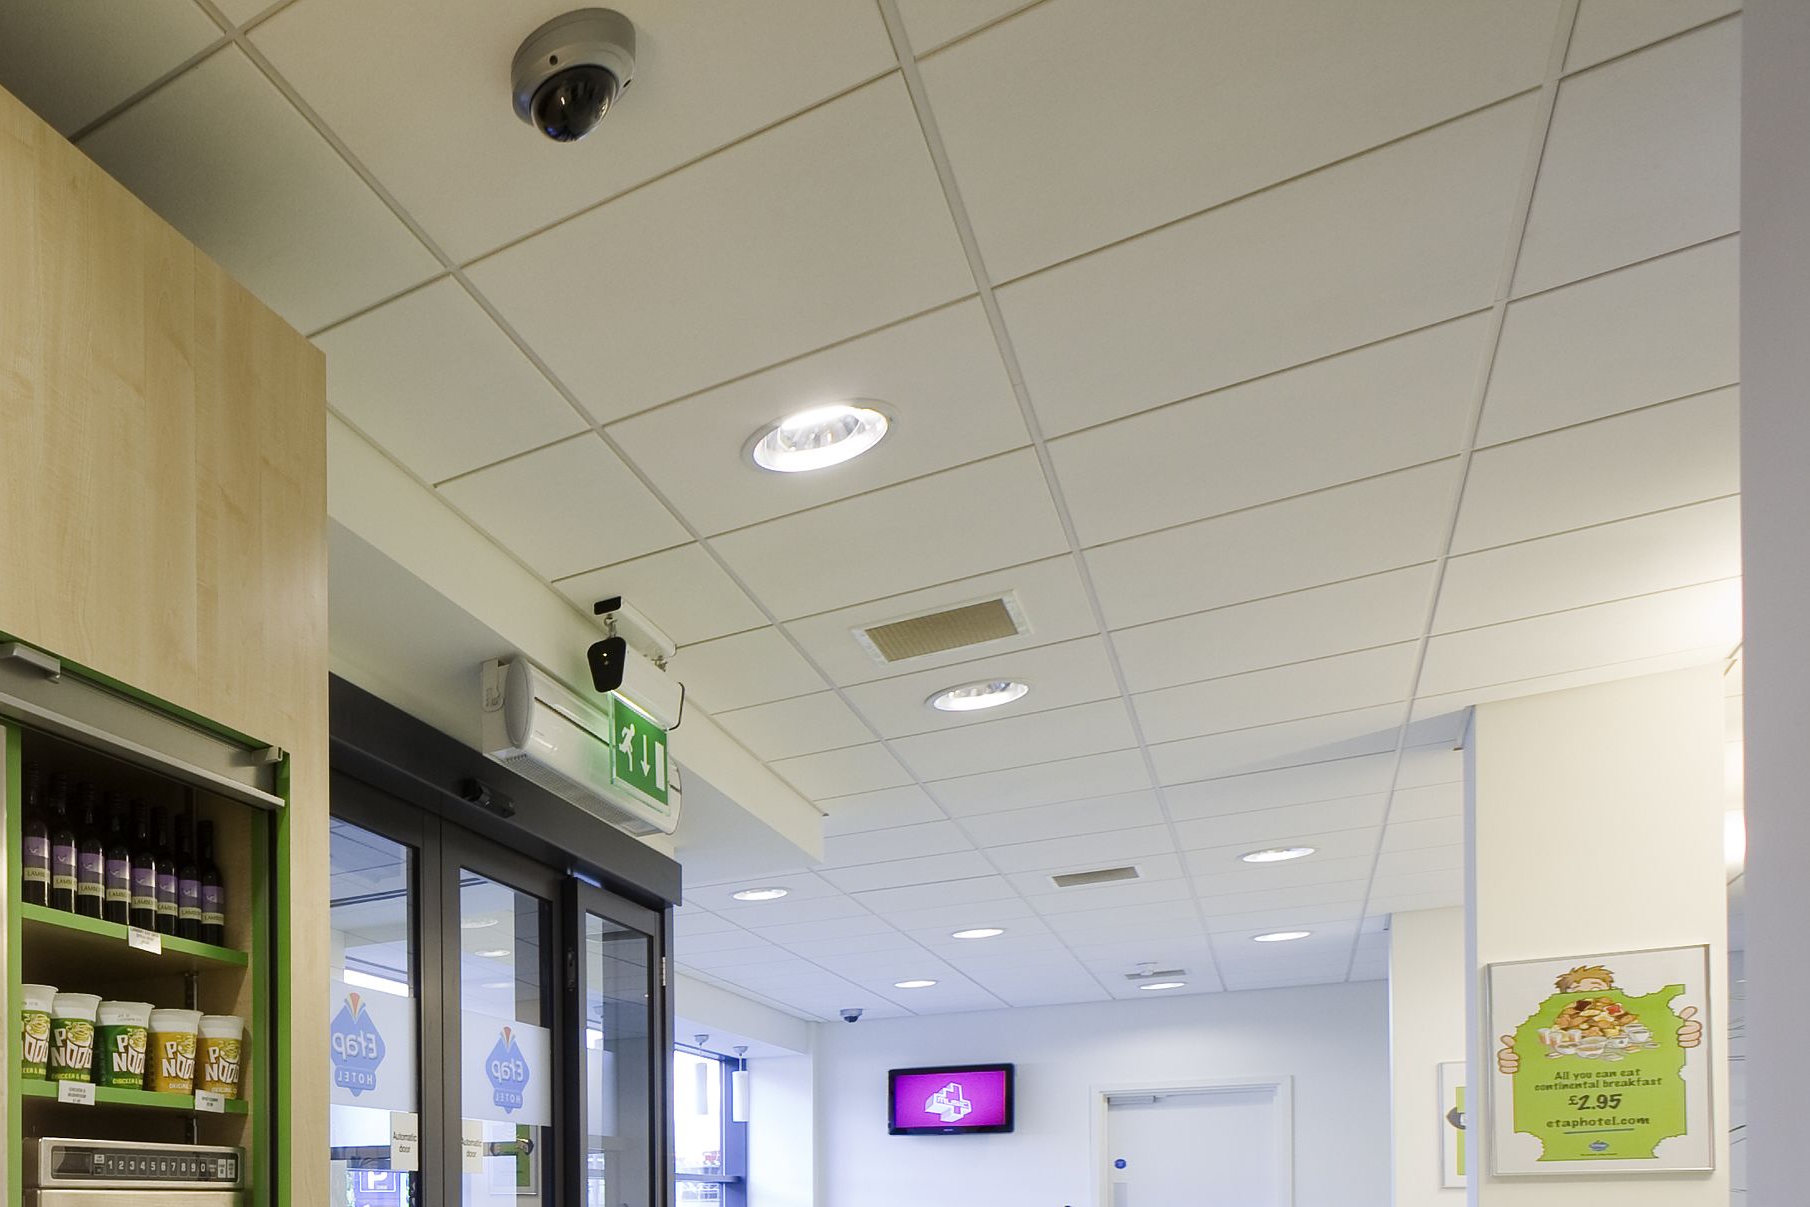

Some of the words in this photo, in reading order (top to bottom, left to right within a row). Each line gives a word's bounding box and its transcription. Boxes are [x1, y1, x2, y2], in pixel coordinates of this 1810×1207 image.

[1554, 1071, 1570, 1081] All
[1572, 1071, 1593, 1081] you
[1595, 1070, 1618, 1079] can
[1620, 1068, 1642, 1077] eat
[1534, 1080, 1600, 1092] continental
[1602, 1077, 1663, 1089] breakfast
[1568, 1093, 1623, 1111] £2.95
[1546, 1116, 1651, 1129] etaphotel.com
[392, 1131, 418, 1144] Automatic
[398, 1144, 411, 1155] door
